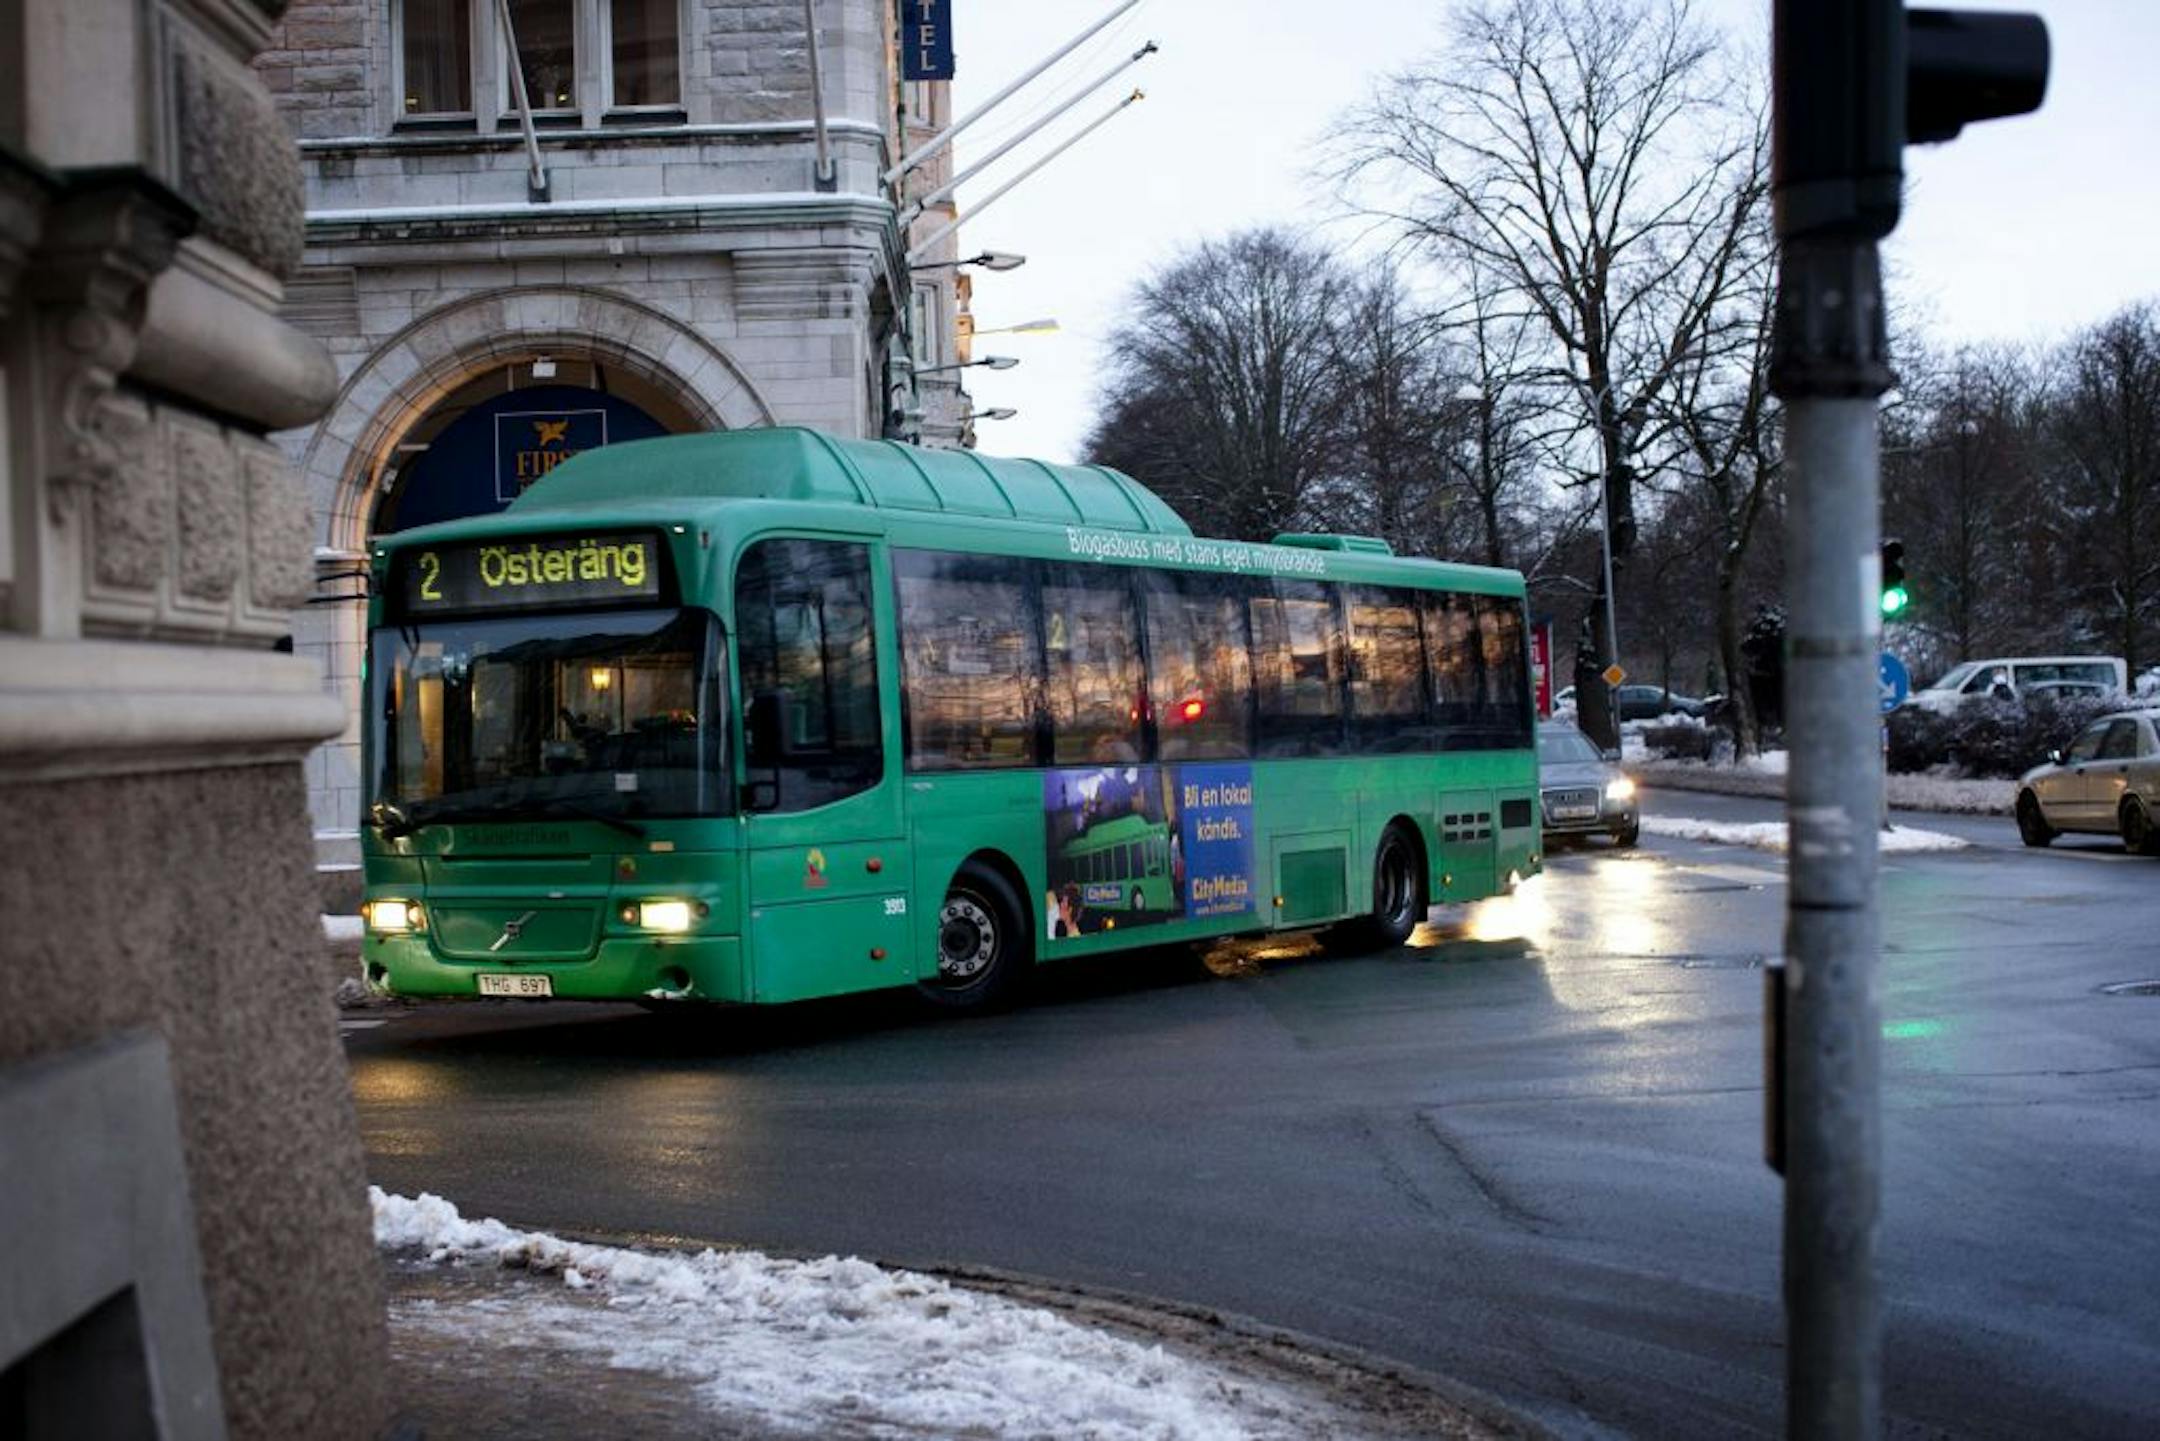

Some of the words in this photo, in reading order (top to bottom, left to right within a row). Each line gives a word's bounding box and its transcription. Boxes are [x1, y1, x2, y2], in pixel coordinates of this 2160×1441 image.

[1066, 527, 1149, 560] Biogasbuss
[1153, 540, 1182, 562] med
[1184, 543, 1221, 566] stans
[1223, 545, 1251, 572] eget
[420, 552, 442, 599] 2
[480, 540, 647, 586] Österäng
[1184, 784, 1199, 809] Bli
[1201, 788, 1218, 807] en
[1220, 782, 1252, 806] lokal
[483, 976, 511, 992] THG
[521, 978, 547, 993] 697
